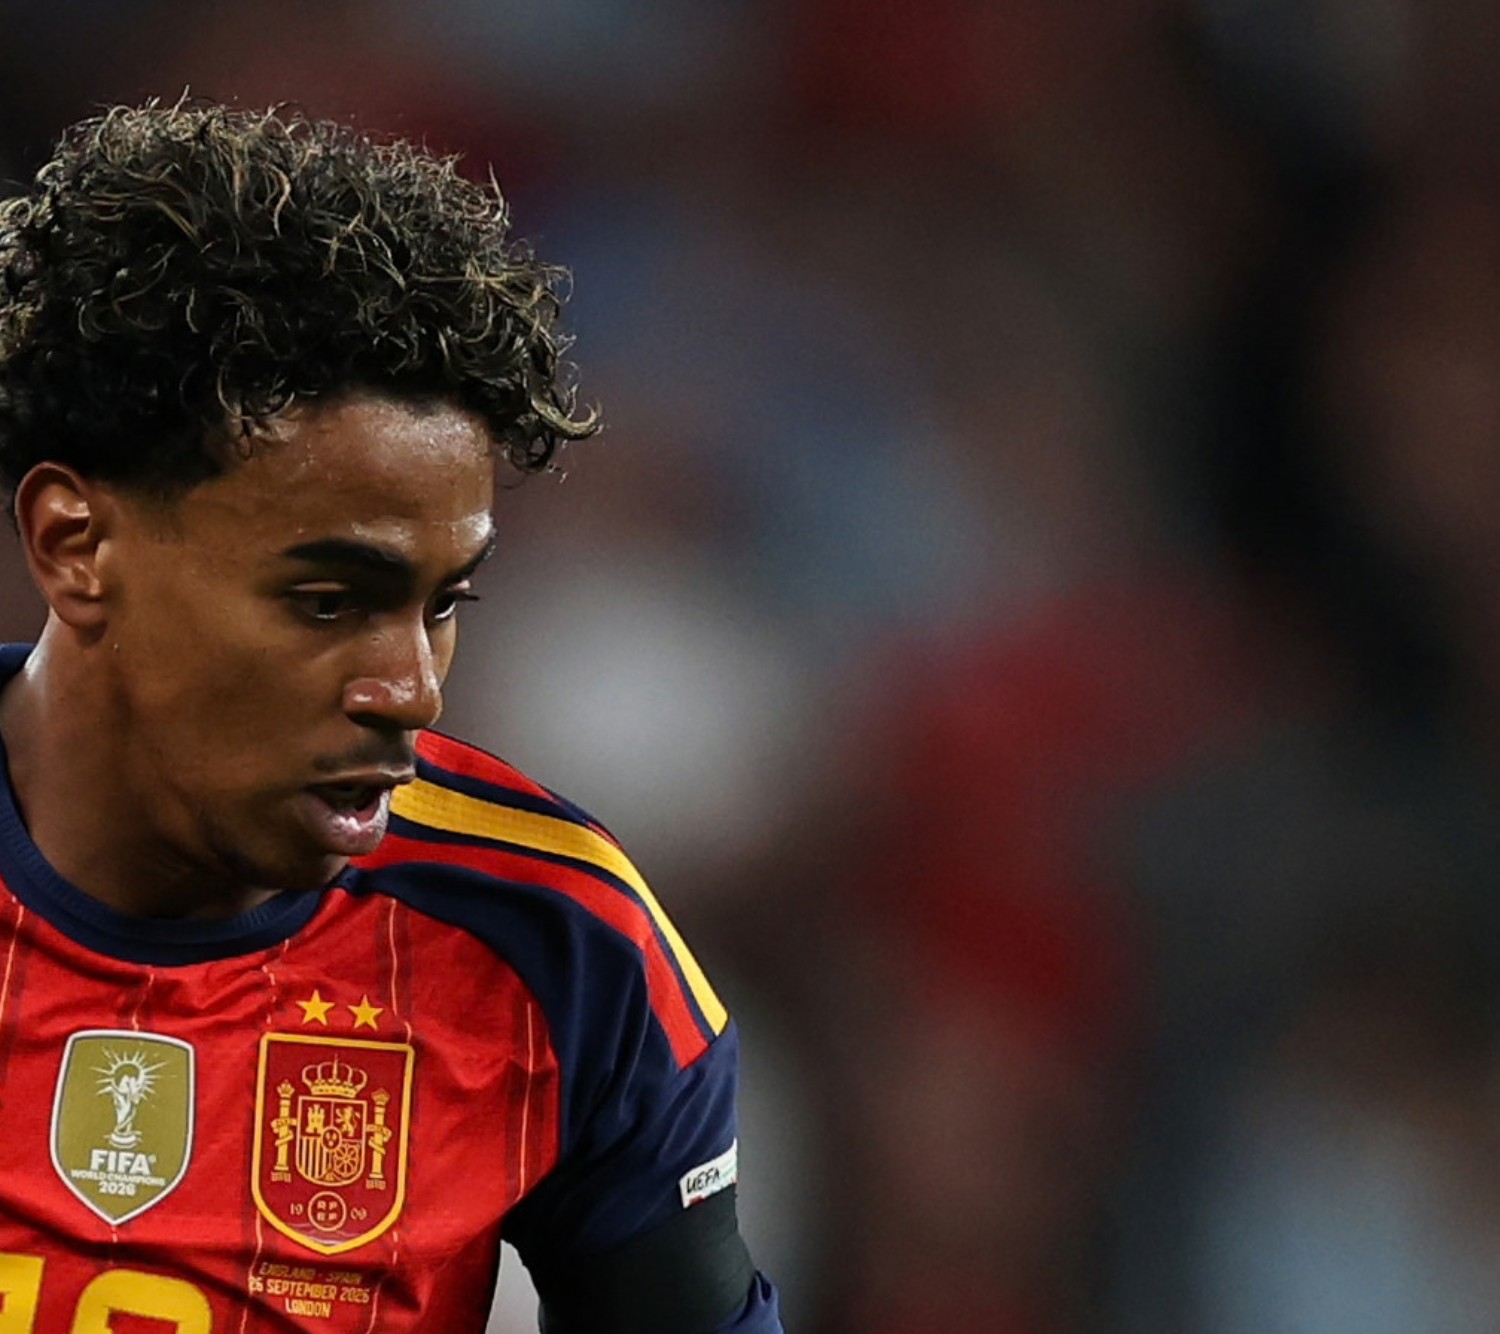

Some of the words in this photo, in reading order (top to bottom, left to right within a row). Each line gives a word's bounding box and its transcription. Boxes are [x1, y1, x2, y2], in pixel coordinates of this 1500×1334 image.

[90, 1149, 151, 1176] FIFA
[70, 1169, 105, 1181] WORLD
[687, 1167, 720, 1194] UEFA
[98, 1181, 136, 1196] 2026
[266, 1278, 338, 1300] SEPTEMBER
[284, 1297, 332, 1318] LONDON
